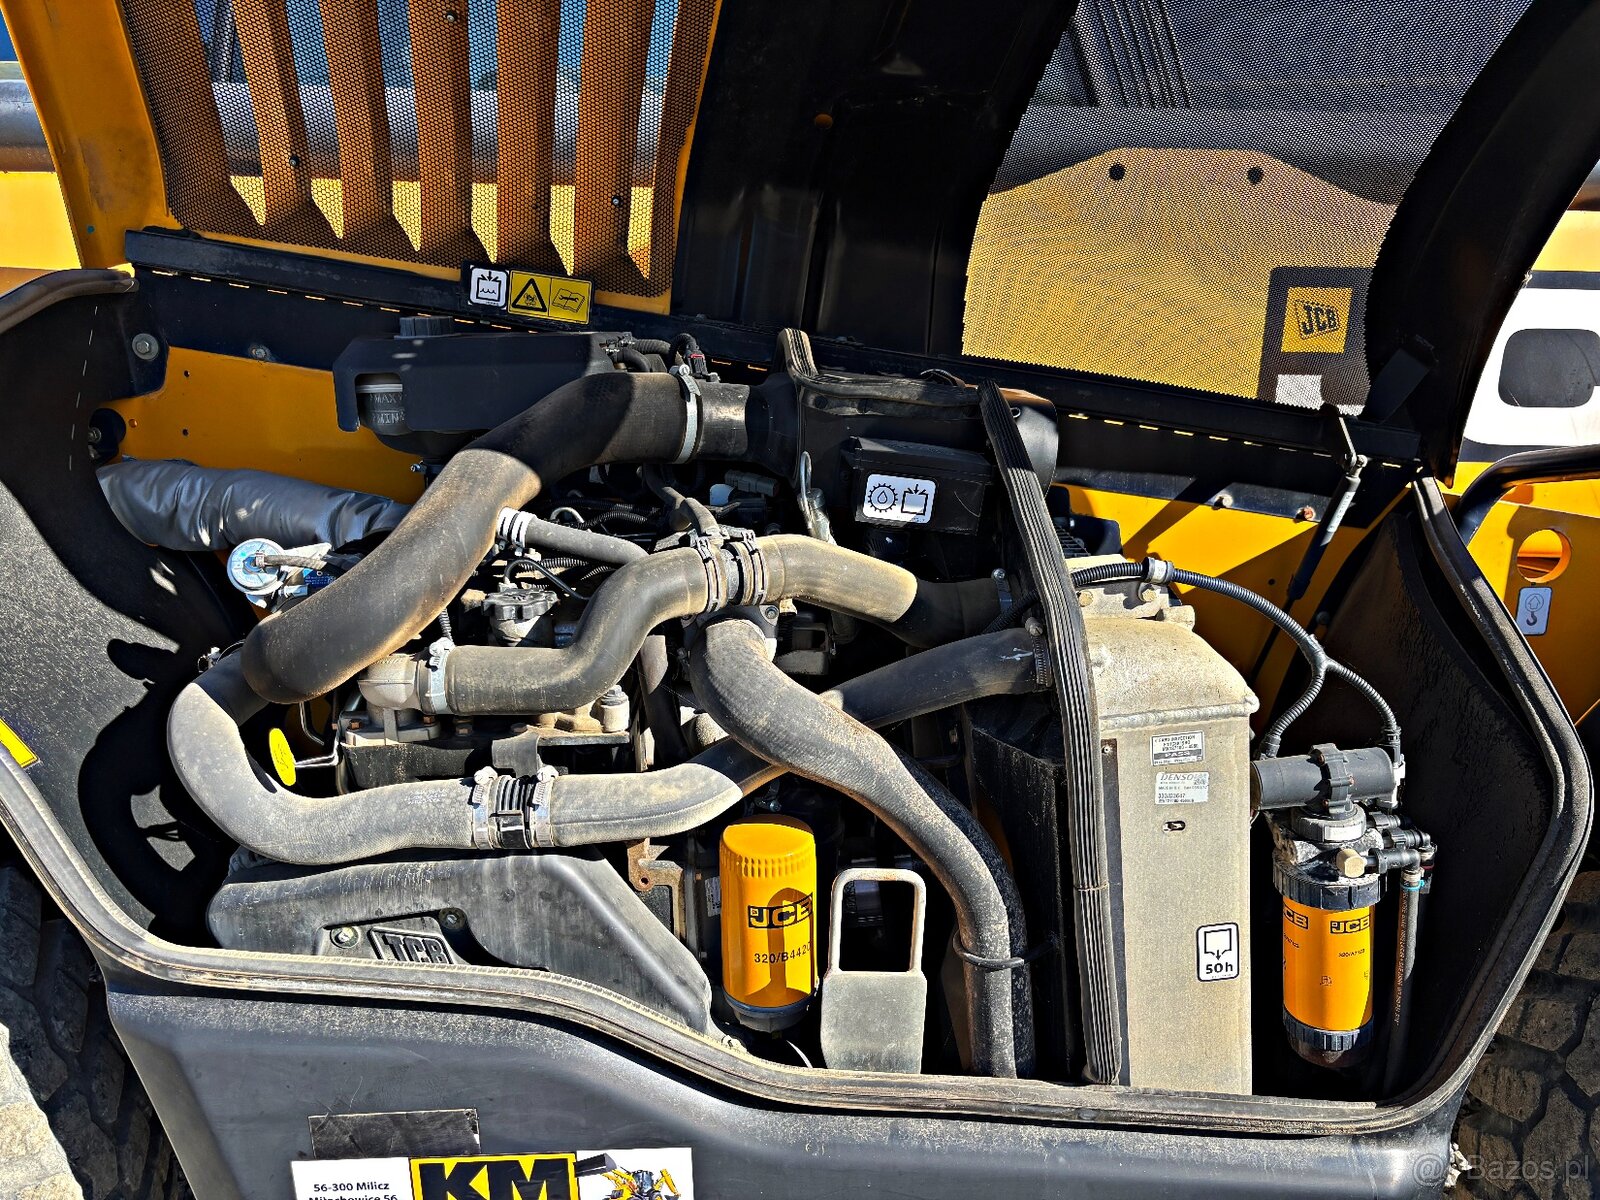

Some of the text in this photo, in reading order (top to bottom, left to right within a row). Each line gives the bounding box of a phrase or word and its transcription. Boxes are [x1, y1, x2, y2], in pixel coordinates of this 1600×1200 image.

[1301, 303, 1338, 335] JCB
[374, 393, 397, 404] MAX
[377, 412, 400, 424] MIN
[1160, 773, 1194, 781] DENSO
[748, 893, 813, 929] JCB
[1283, 904, 1309, 930] CB
[1330, 915, 1370, 934] JCB
[313, 1181, 390, 1192] 56-300 Milicz
[418, 1157, 574, 1200] KM
